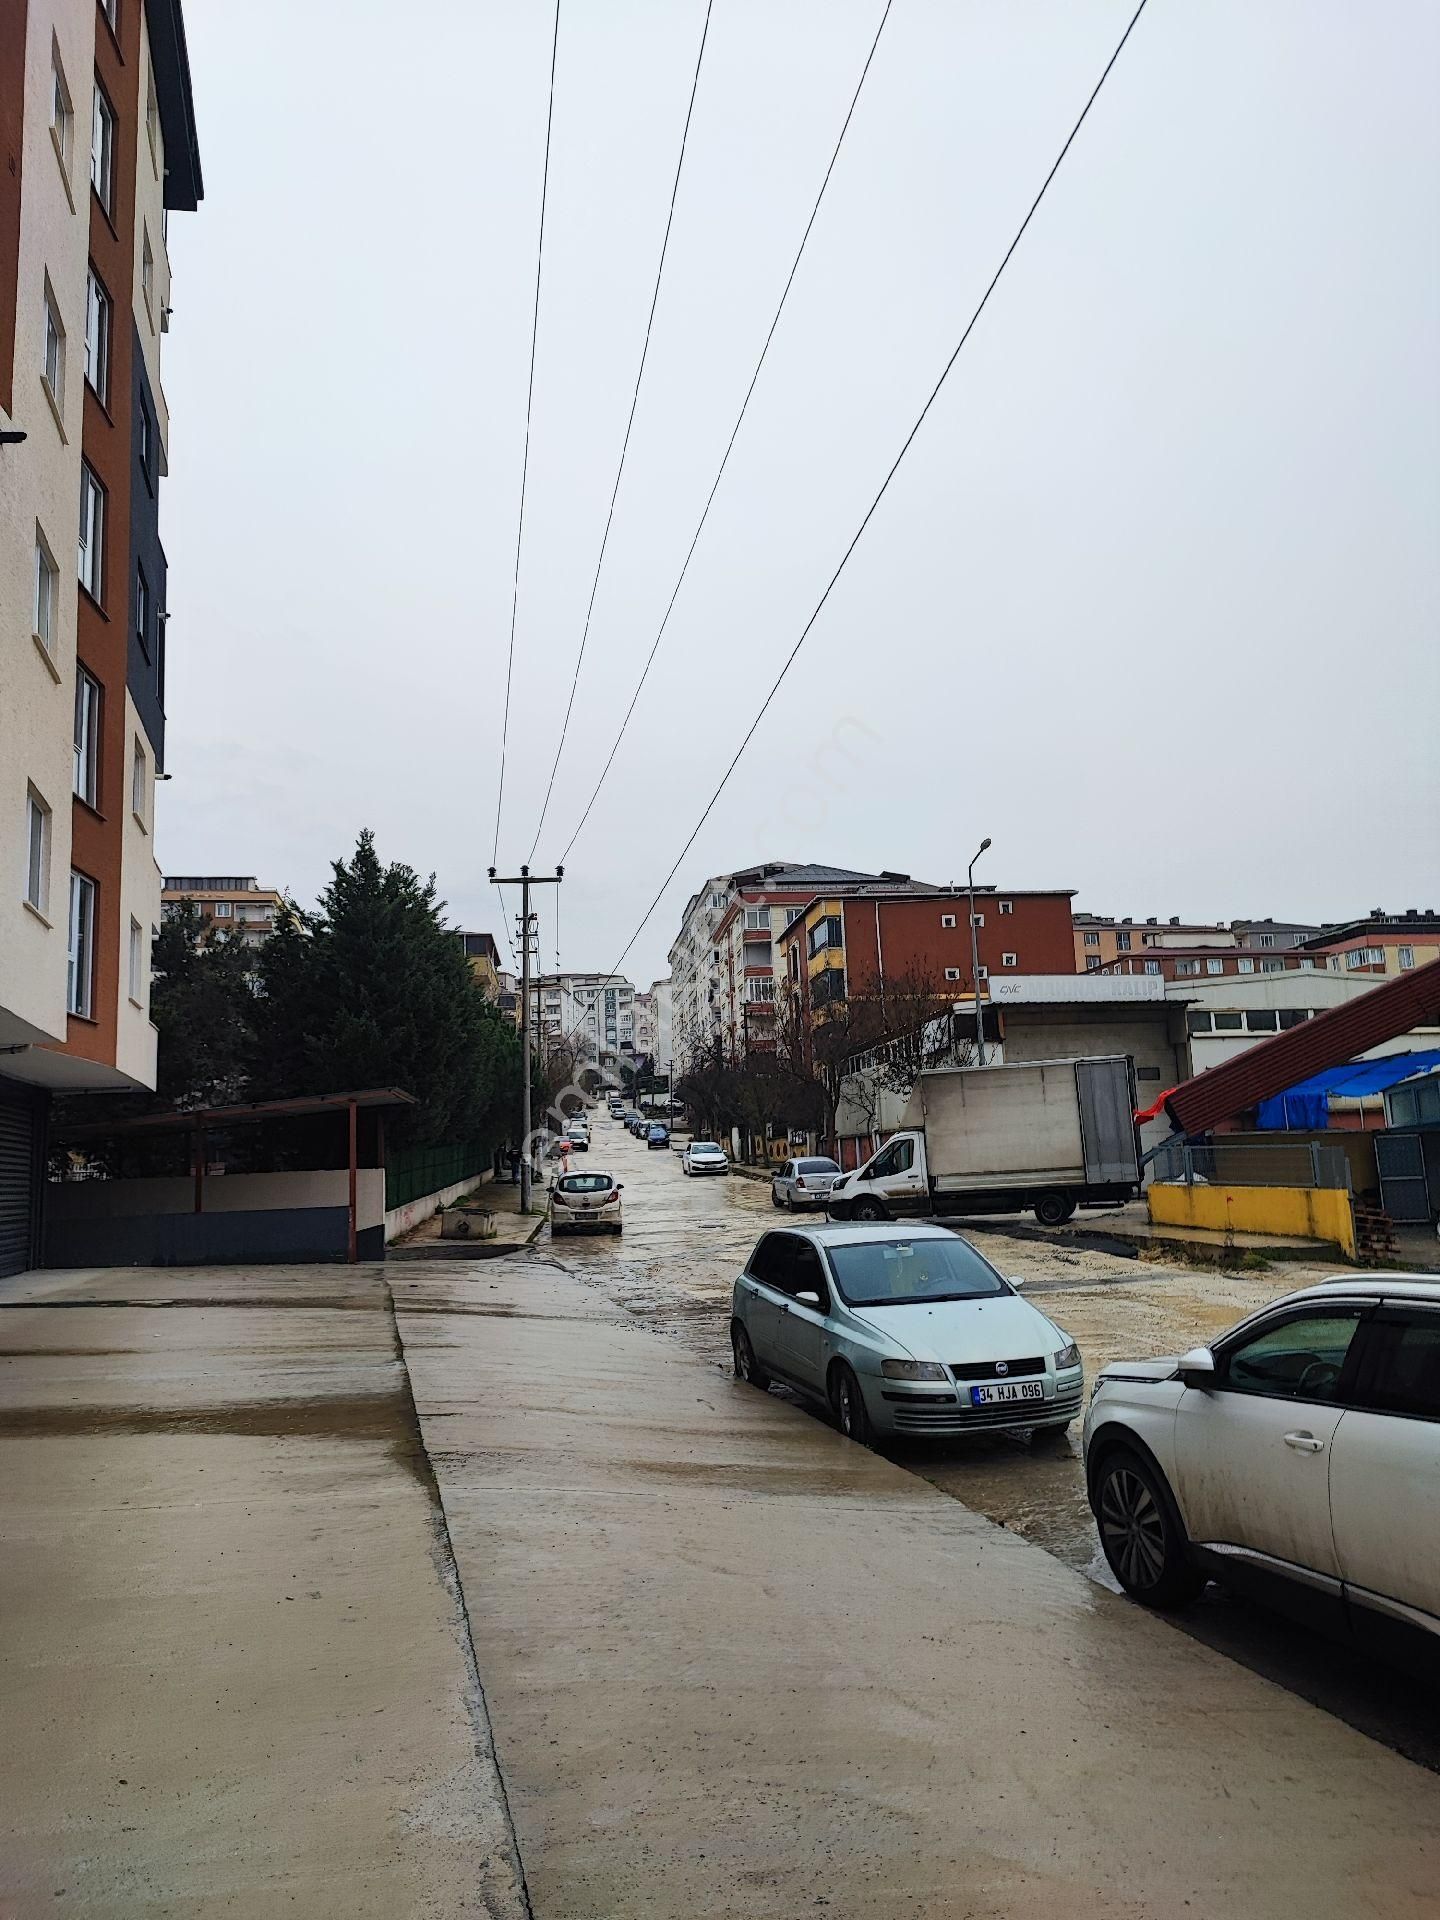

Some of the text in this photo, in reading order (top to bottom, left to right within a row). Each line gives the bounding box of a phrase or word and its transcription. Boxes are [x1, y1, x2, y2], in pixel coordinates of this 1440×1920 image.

[1111, 980, 1159, 997] KALIP
[980, 1388, 993, 1402] 34
[998, 1386, 1018, 1400] HJA
[1022, 1384, 1041, 1398] 096
